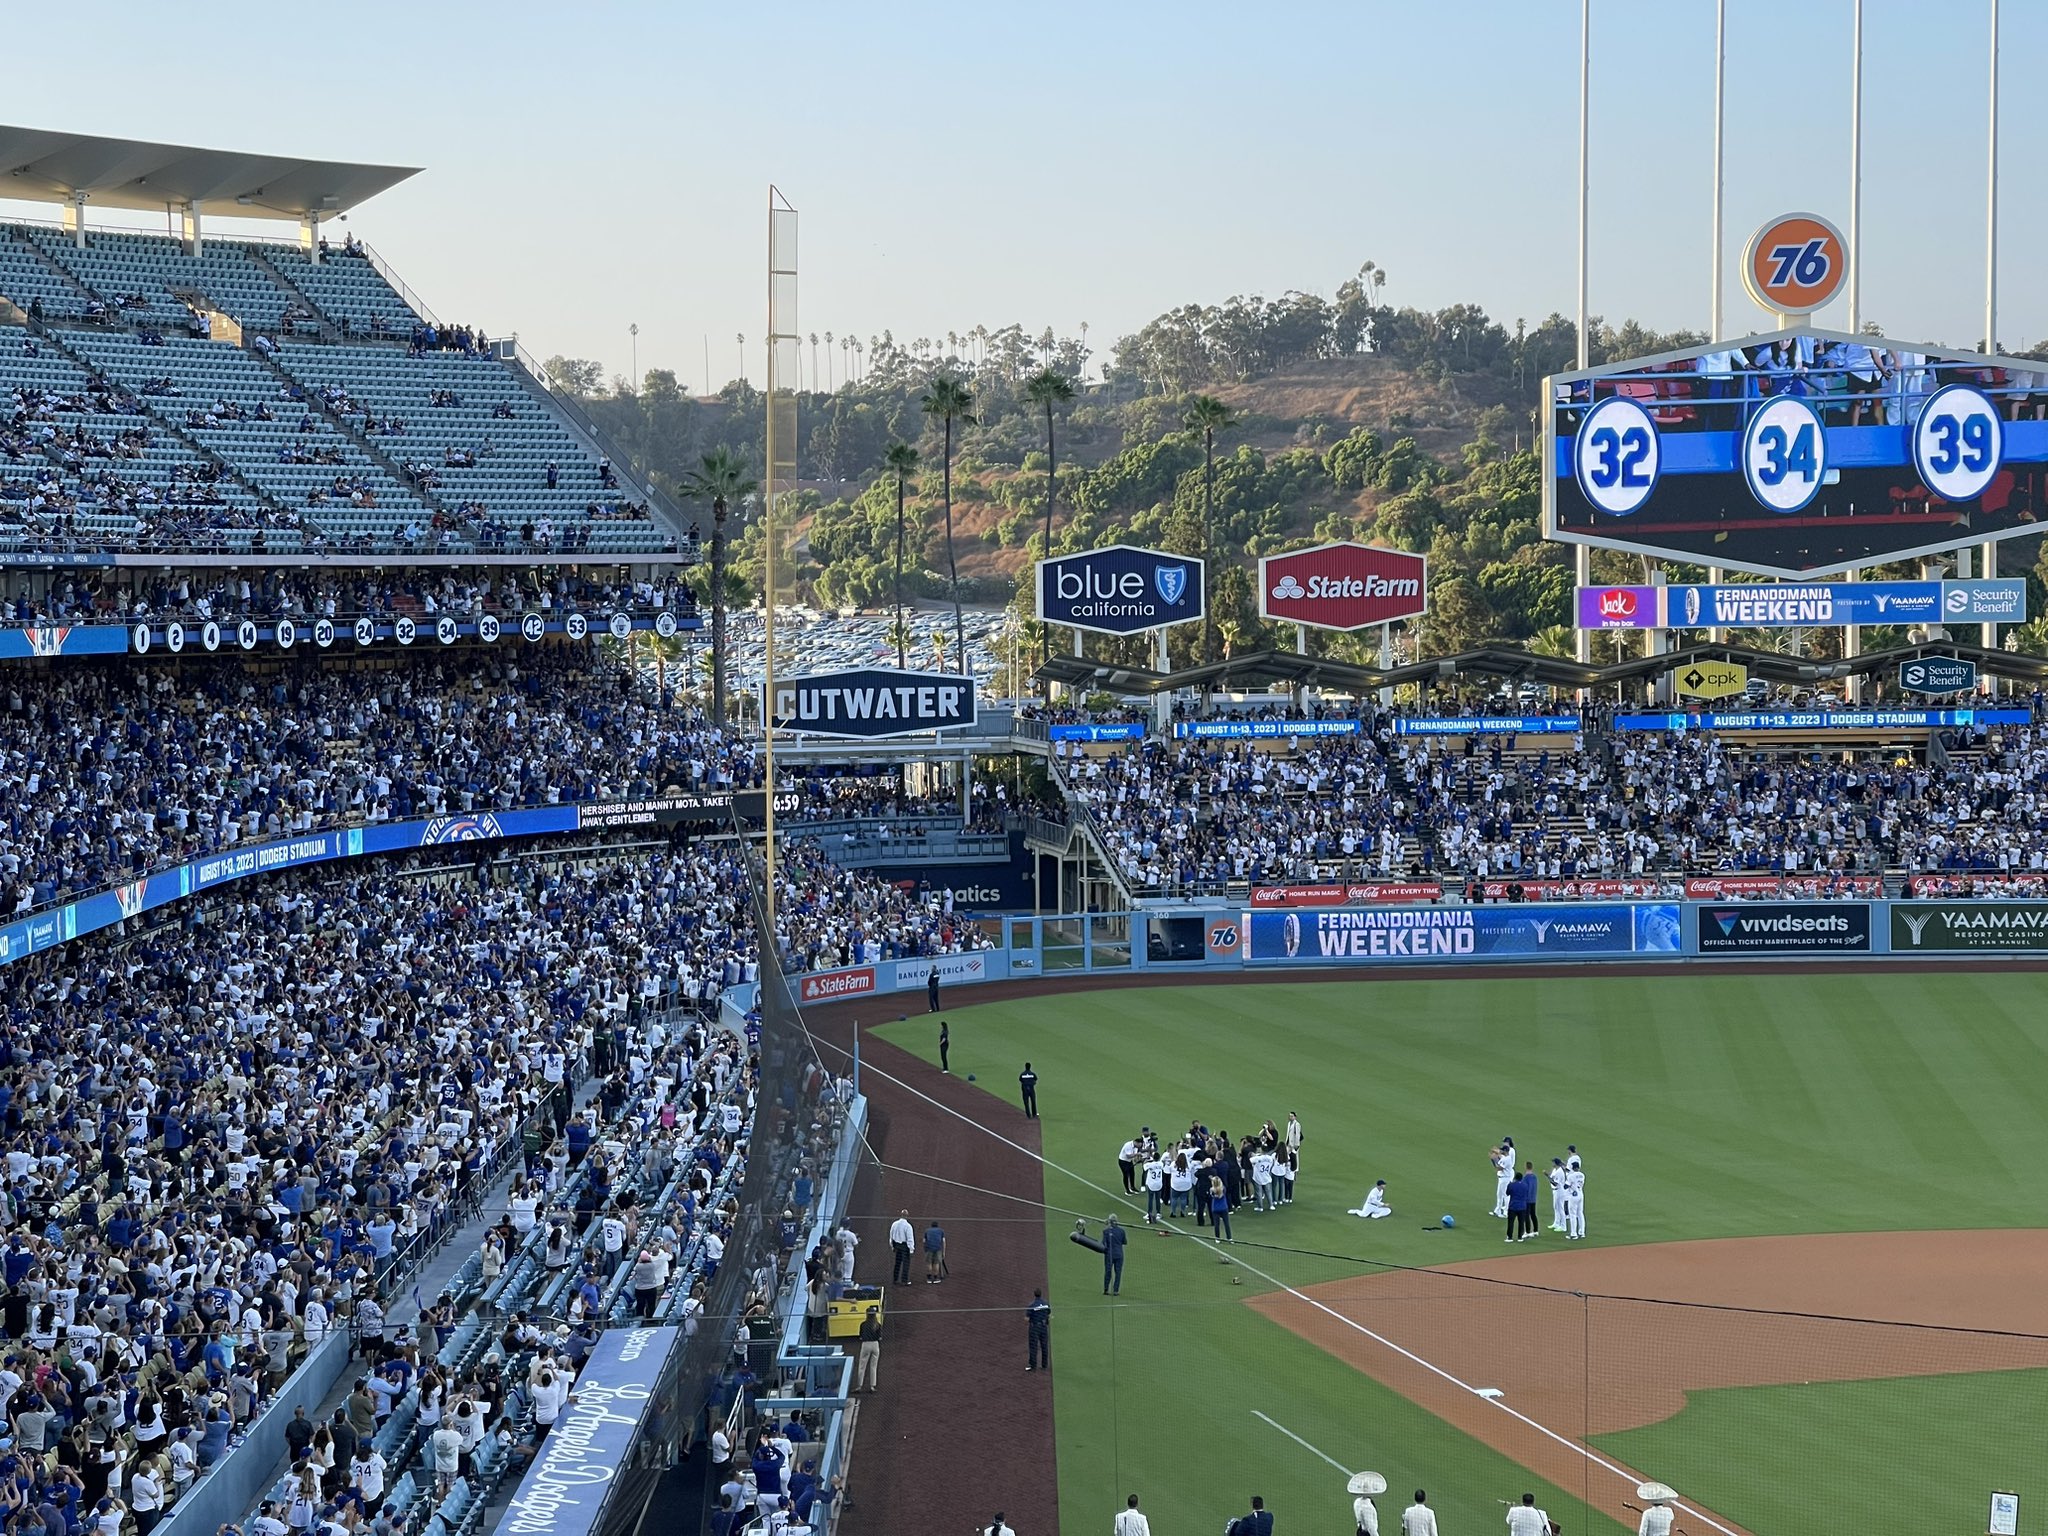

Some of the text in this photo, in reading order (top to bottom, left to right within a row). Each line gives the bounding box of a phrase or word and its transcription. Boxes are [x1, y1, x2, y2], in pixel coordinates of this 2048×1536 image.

[1767, 238, 1830, 288] 76
[1930, 413, 1992, 474] 39
[1591, 426, 1650, 488] 32
[1759, 423, 1817, 485] 34
[1058, 565, 1144, 599] blue
[1716, 588, 1832, 601] FERNANDOMANIA
[1972, 588, 2020, 602] Security
[1071, 602, 1155, 616] california
[1601, 592, 1635, 614] Jack
[1716, 600, 1832, 621] WEEKEND
[1974, 600, 2013, 612] Benefit
[317, 626, 332, 640] 20
[357, 625, 372, 639] 24
[398, 624, 413, 639] 32
[440, 624, 456, 638] 34
[482, 623, 497, 636] 39
[525, 619, 542, 635] 42
[569, 619, 584, 634] 53
[140, 631, 145, 646] 1
[172, 630, 180, 644] 2
[208, 628, 215, 644] 4
[243, 628, 254, 642] 14
[281, 627, 292, 642] 19
[1928, 665, 1968, 678] Security
[1708, 671, 1738, 688] cpk
[1929, 675, 1963, 686] Benefit
[777, 686, 960, 720] CUTWATER
[1410, 720, 1480, 730] FERNANDOMANIA
[1482, 720, 1523, 729] WEEKEND
[1714, 712, 1927, 726] AUGUST 11-13, 2023 DODGER STADIUM
[1196, 724, 1354, 734] AUGUST 11-13, 2023 DODGER STADIUM
[581, 804, 626, 816] HERSHISER
[628, 802, 644, 813] AND
[645, 800, 674, 811] MANNY
[702, 797, 723, 808] TAKE
[773, 795, 800, 811] 6:59
[581, 812, 656, 828] AWAY, GENTLEMEN.
[200, 860, 221, 883] AUGUST
[236, 854, 254, 871] 2023
[260, 846, 288, 866] DODGER
[290, 839, 326, 861] STADIUM
[1318, 911, 1474, 928] FERNANDOMANIA
[1741, 914, 1848, 932] vividseats
[1211, 926, 1237, 948] 76
[1318, 928, 1474, 956] WEEKEND
[898, 971, 918, 980] BANK
[1152, 1171, 1160, 1180] 34
[1260, 1164, 1269, 1173] 34
[546, 1404, 638, 1463] Angeles
[508, 1462, 614, 1533] Dodgers
